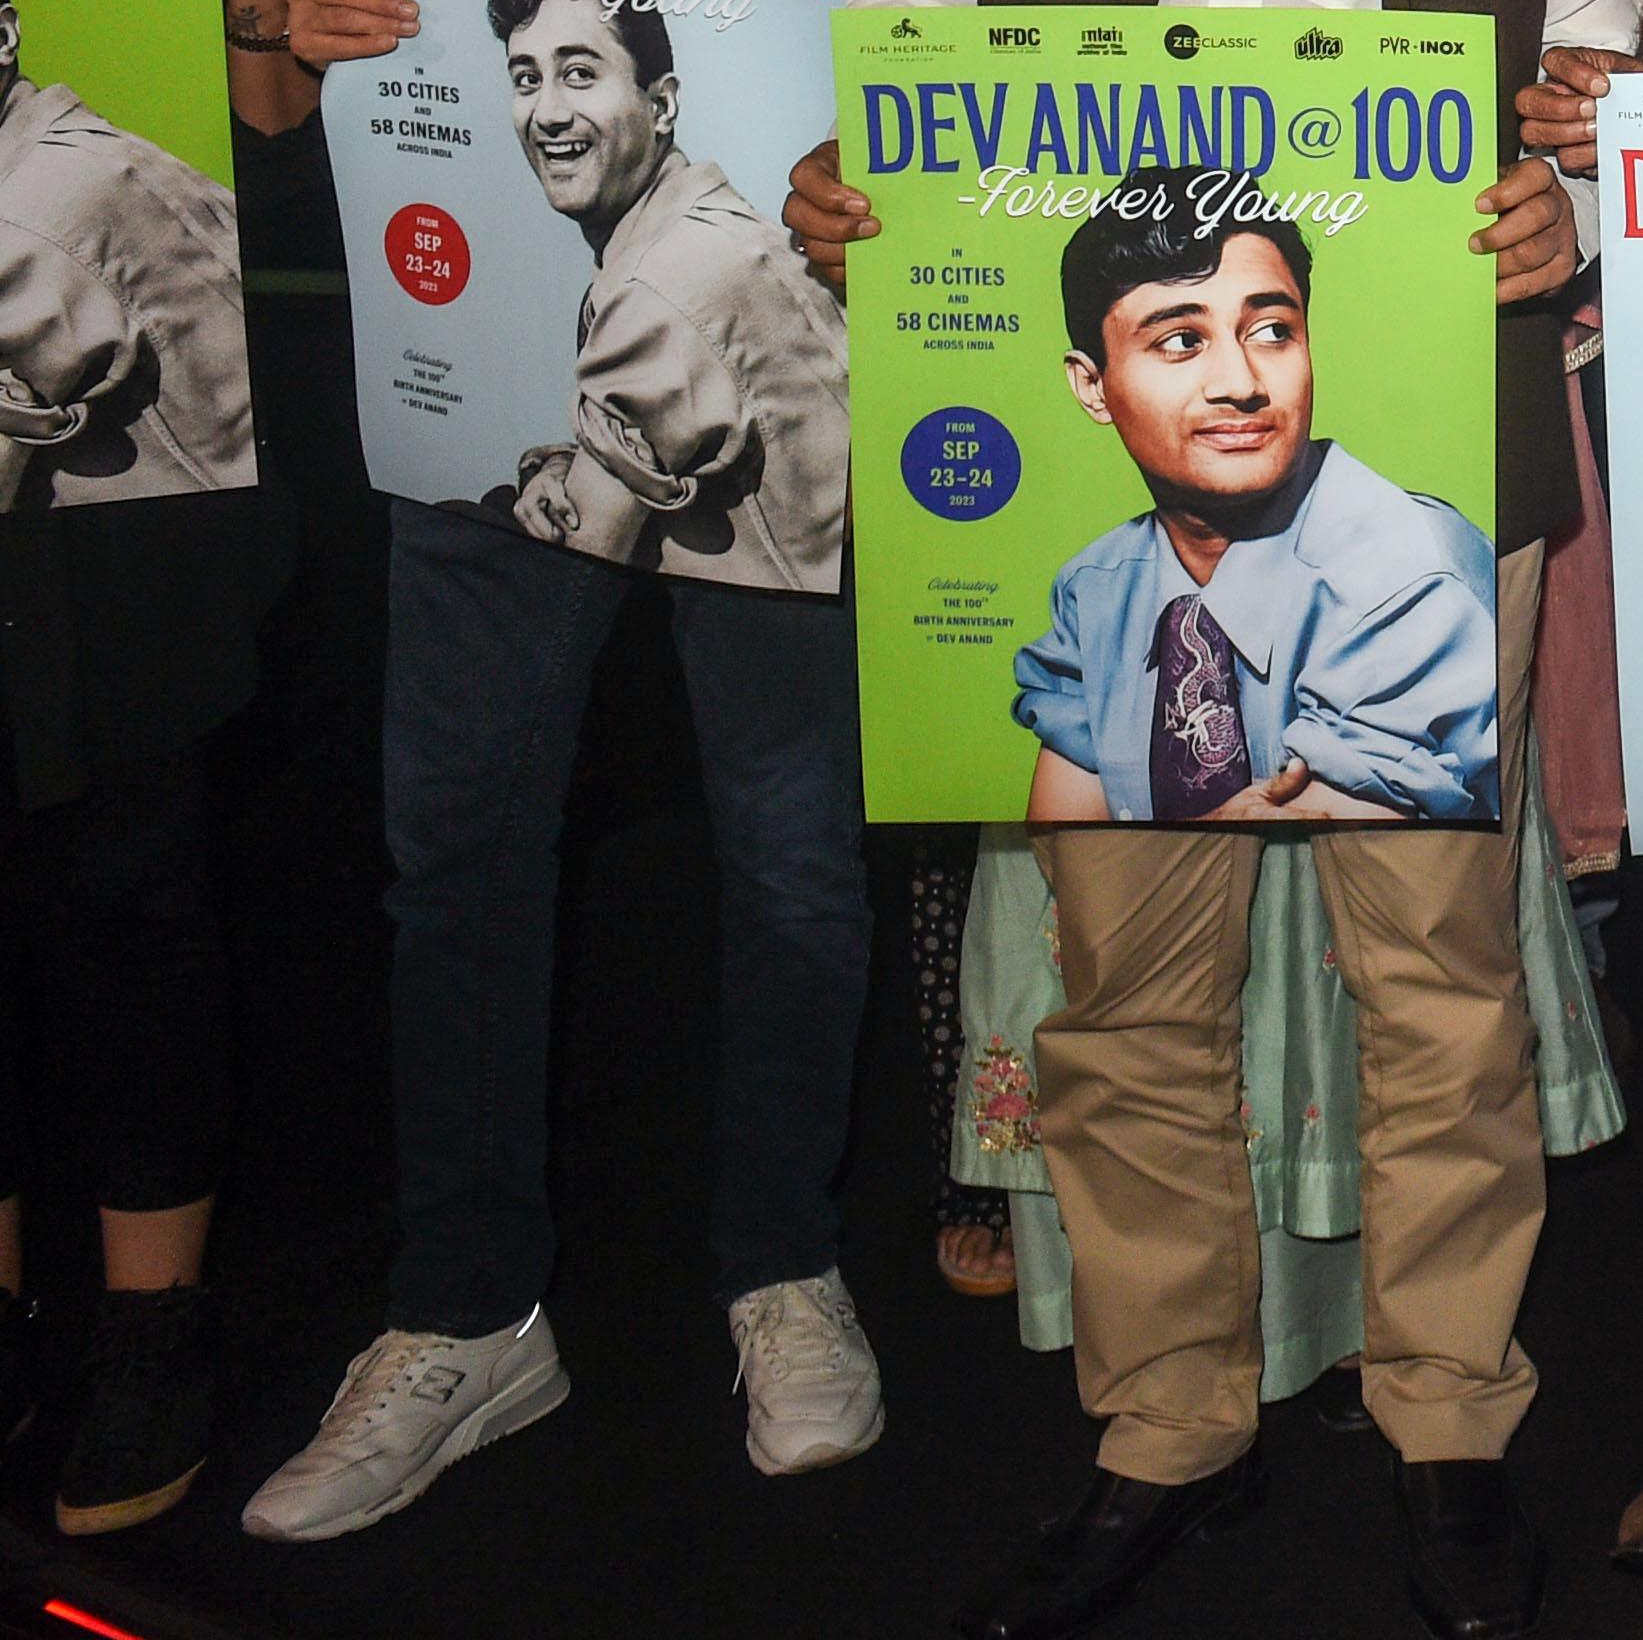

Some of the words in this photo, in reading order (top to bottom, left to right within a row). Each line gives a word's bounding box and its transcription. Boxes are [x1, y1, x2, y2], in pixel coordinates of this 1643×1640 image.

[989, 27, 1040, 47] NFDC
[378, 81, 402, 98] 30
[408, 82, 460, 104] CITIES
[371, 119, 394, 136] 58
[399, 120, 471, 146] CINEMAS
[862, 83, 1009, 174] DEV
[1026, 84, 1276, 177] ANAND
[1288, 108, 1342, 158] @
[1352, 87, 1472, 183] 100
[1186, 170, 1369, 240] Young
[415, 232, 442, 252] SEP
[910, 267, 935, 285] 30
[941, 267, 1005, 287] CITIES
[896, 313, 921, 331] 58
[927, 313, 1020, 333] CINEMAS
[943, 441, 980, 461] SEP
